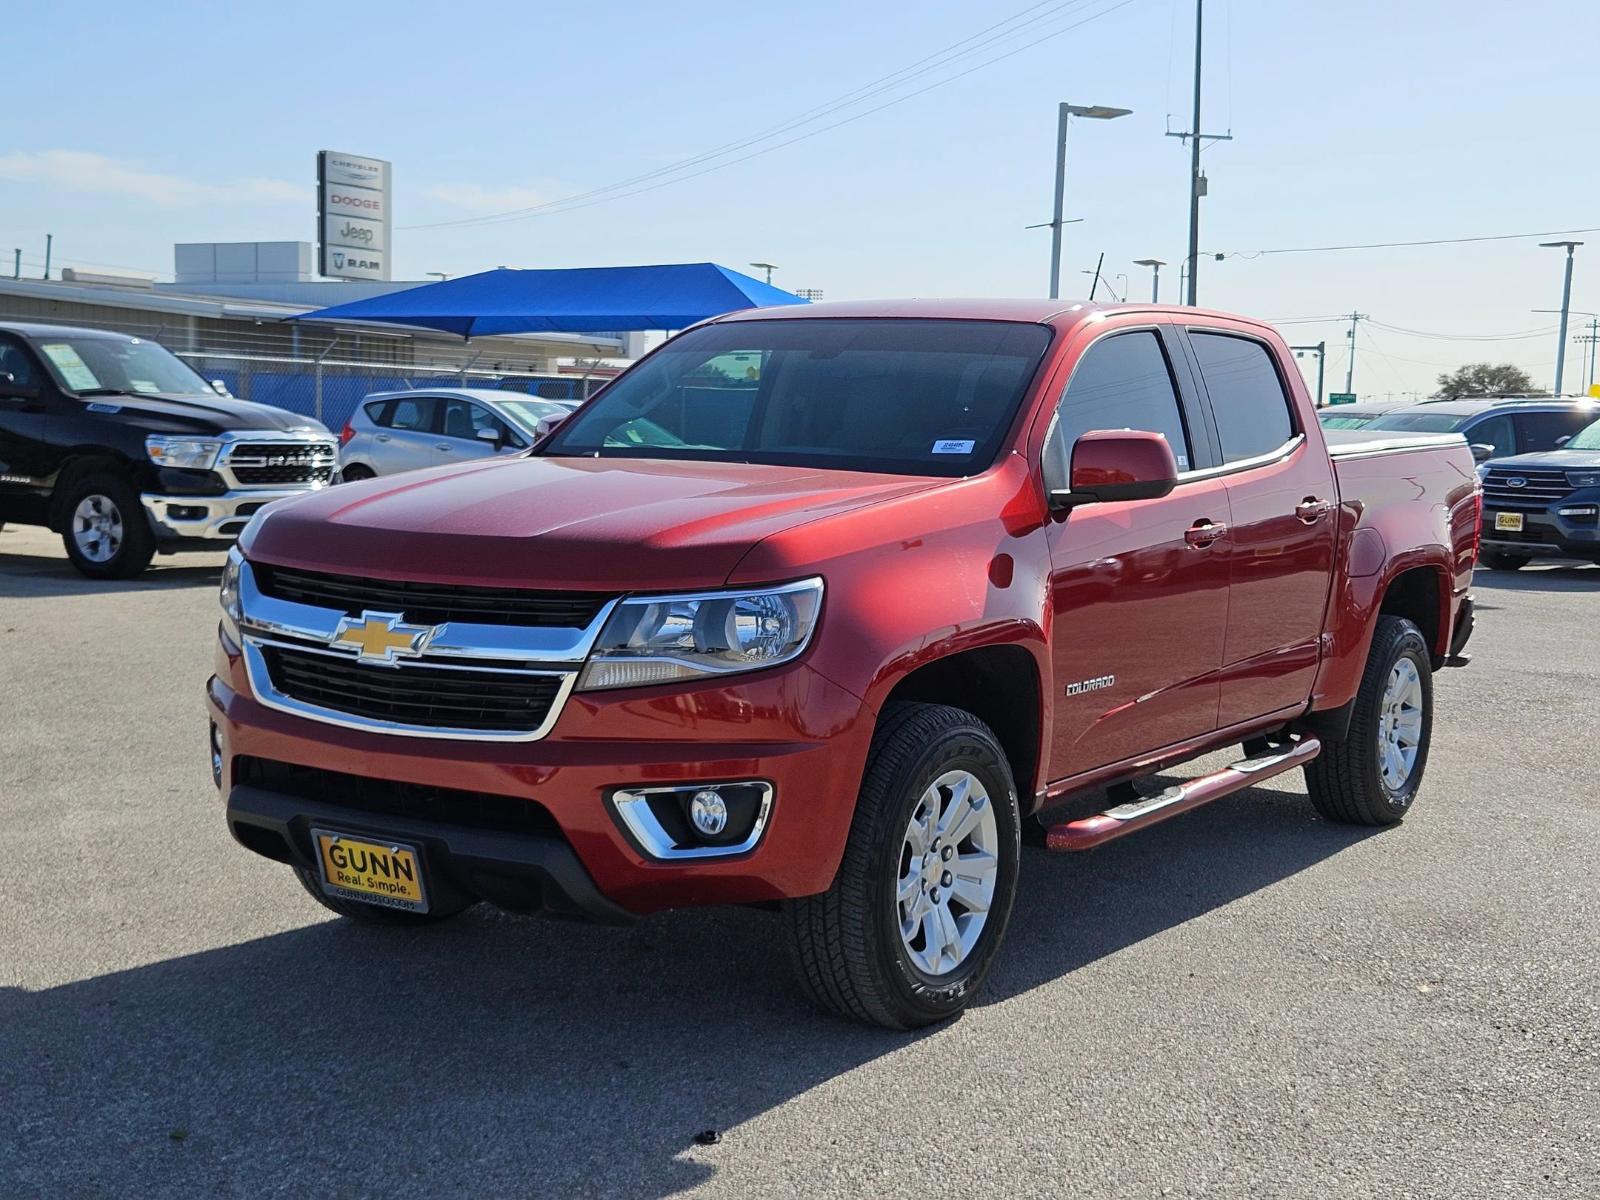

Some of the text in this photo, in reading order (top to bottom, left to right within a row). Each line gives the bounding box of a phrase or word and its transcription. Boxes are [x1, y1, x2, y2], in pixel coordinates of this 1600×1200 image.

[331, 160, 379, 172] CHRYSLER
[331, 194, 380, 210] DODGE
[341, 221, 373, 244] Jeep
[348, 258, 380, 270] RAM
[268, 455, 313, 466] RAM
[1499, 516, 1520, 525] GUNN
[1066, 674, 1115, 697] COLORADO
[329, 844, 413, 881] GUNN
[337, 871, 411, 896] Real. Simple.
